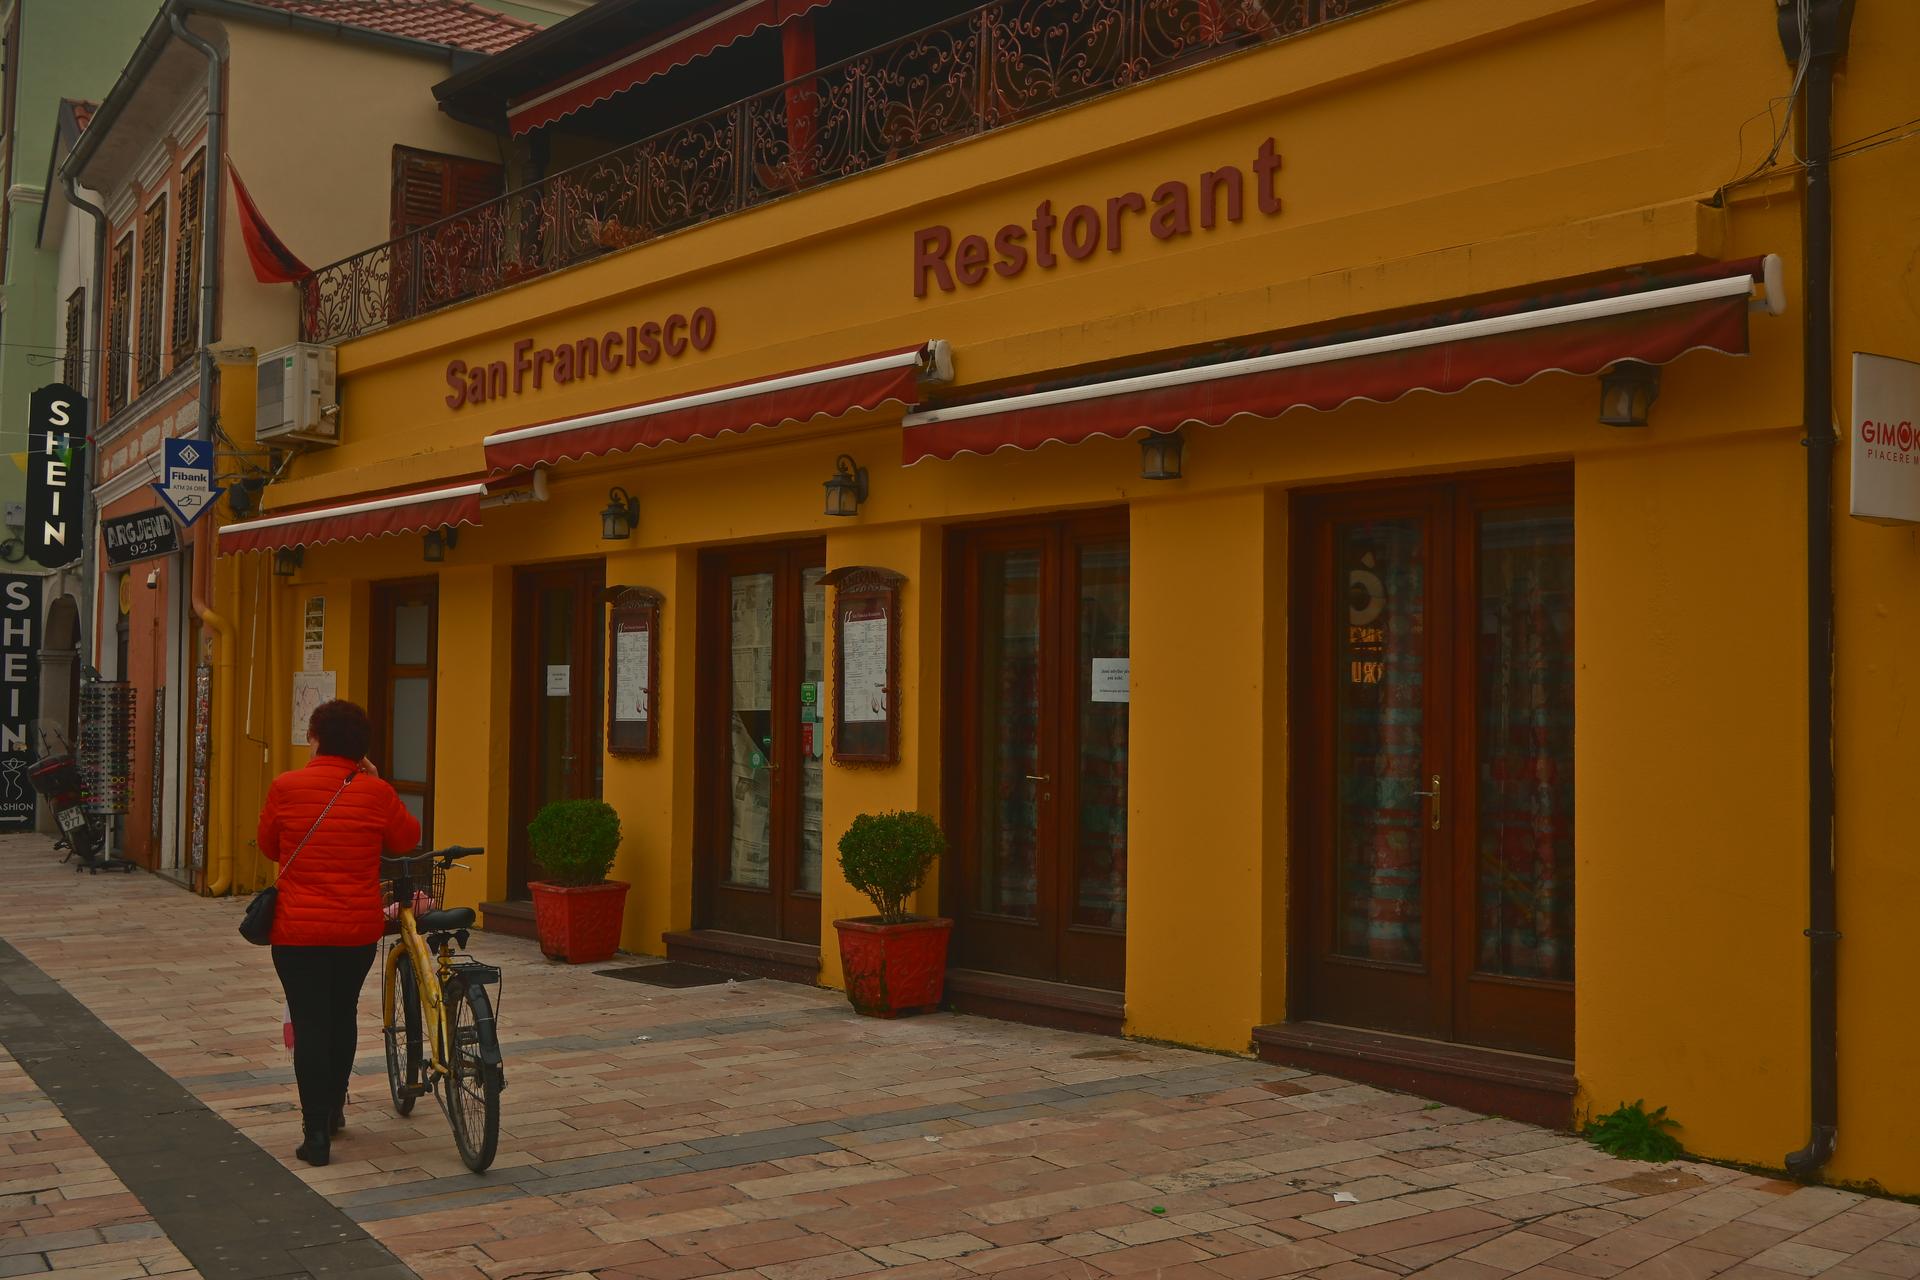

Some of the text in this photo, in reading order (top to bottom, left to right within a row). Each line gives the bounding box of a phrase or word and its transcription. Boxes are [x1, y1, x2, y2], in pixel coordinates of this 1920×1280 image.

[914, 137, 1282, 298] Restorant
[445, 306, 716, 410] San Francisco
[43, 400, 71, 546] SHEIN
[172, 471, 207, 482] Fibank
[1868, 449, 1910, 464] PIACERE
[107, 514, 171, 549] ARGJEND
[130, 539, 157, 556] 925
[1, 581, 31, 753] SHEIN
